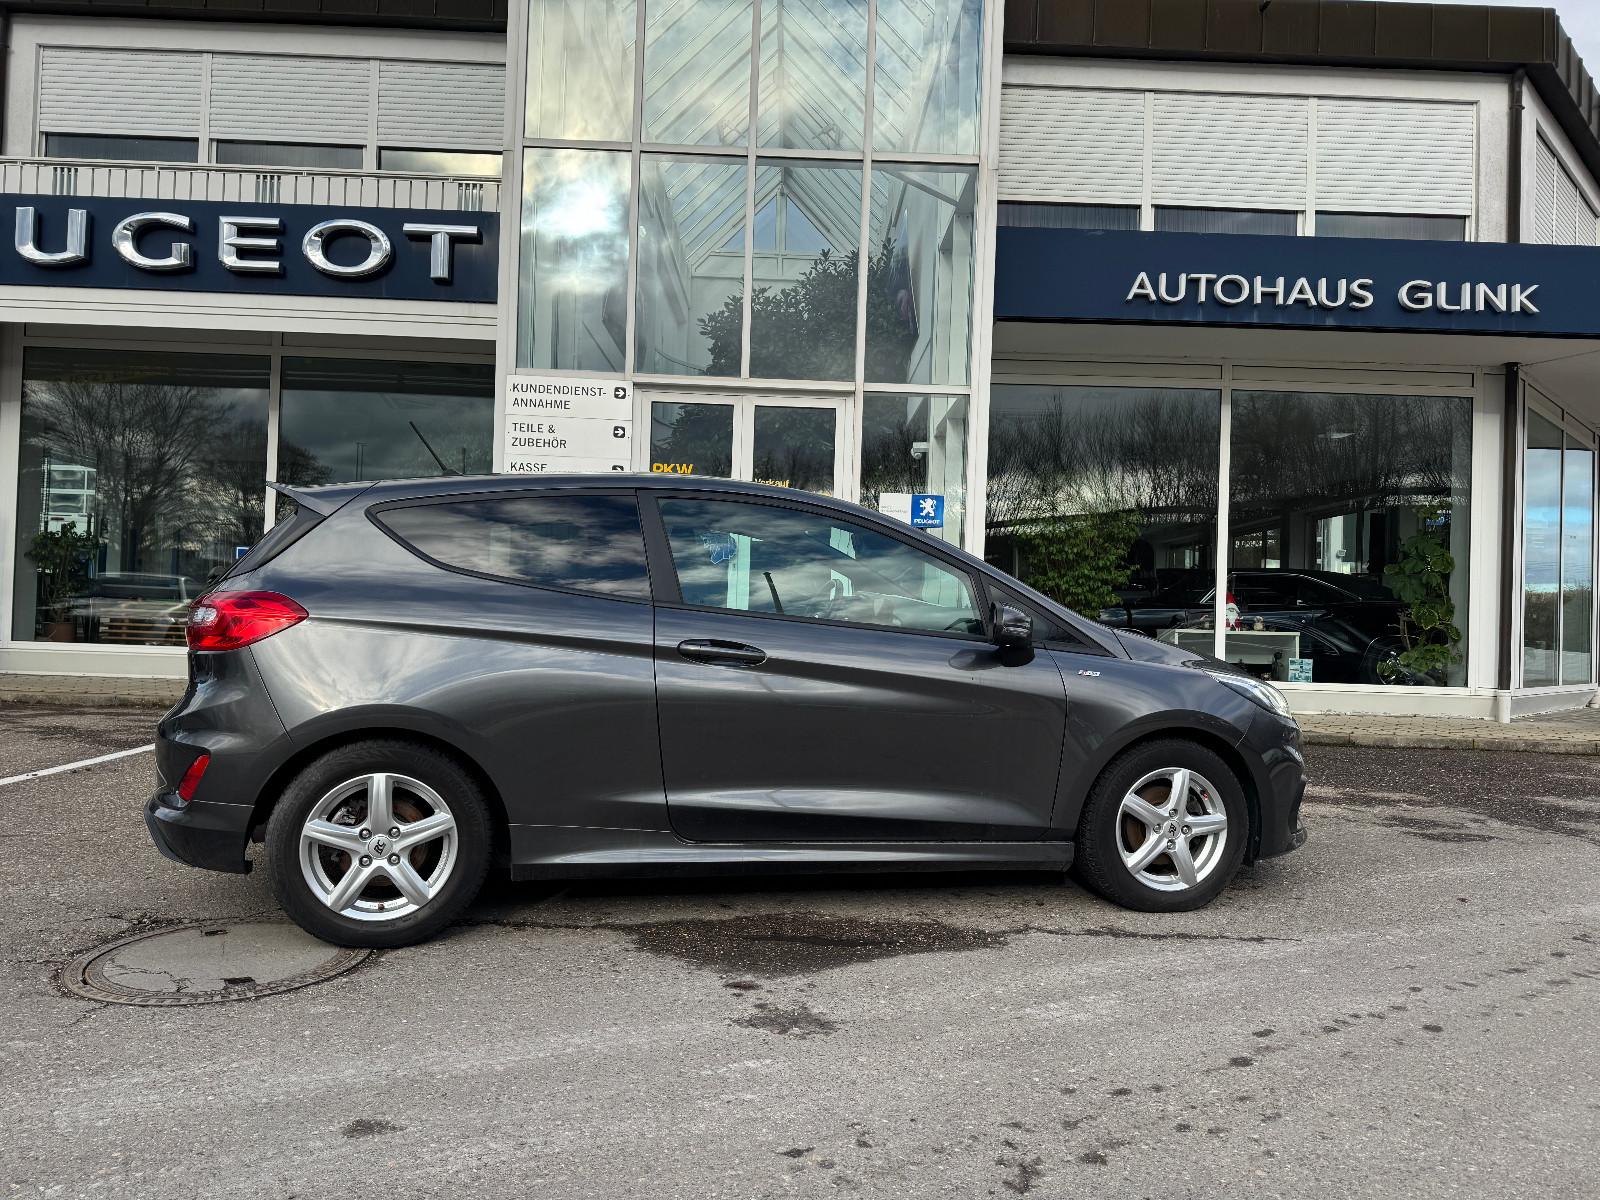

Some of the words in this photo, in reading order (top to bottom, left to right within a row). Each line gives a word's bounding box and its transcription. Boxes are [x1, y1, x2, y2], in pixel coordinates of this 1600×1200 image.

[15, 205, 478, 280] UGEOT
[1126, 271, 1373, 310] AUTOHAUS
[1397, 279, 1540, 313] GLINK
[512, 383, 607, 397] KUNDENDIENST-
[512, 397, 571, 410] ANNAHME
[512, 422, 544, 434] TEILE
[547, 424, 556, 434] &
[511, 436, 567, 449] ZUBEHÖR
[510, 461, 548, 472] KASSE
